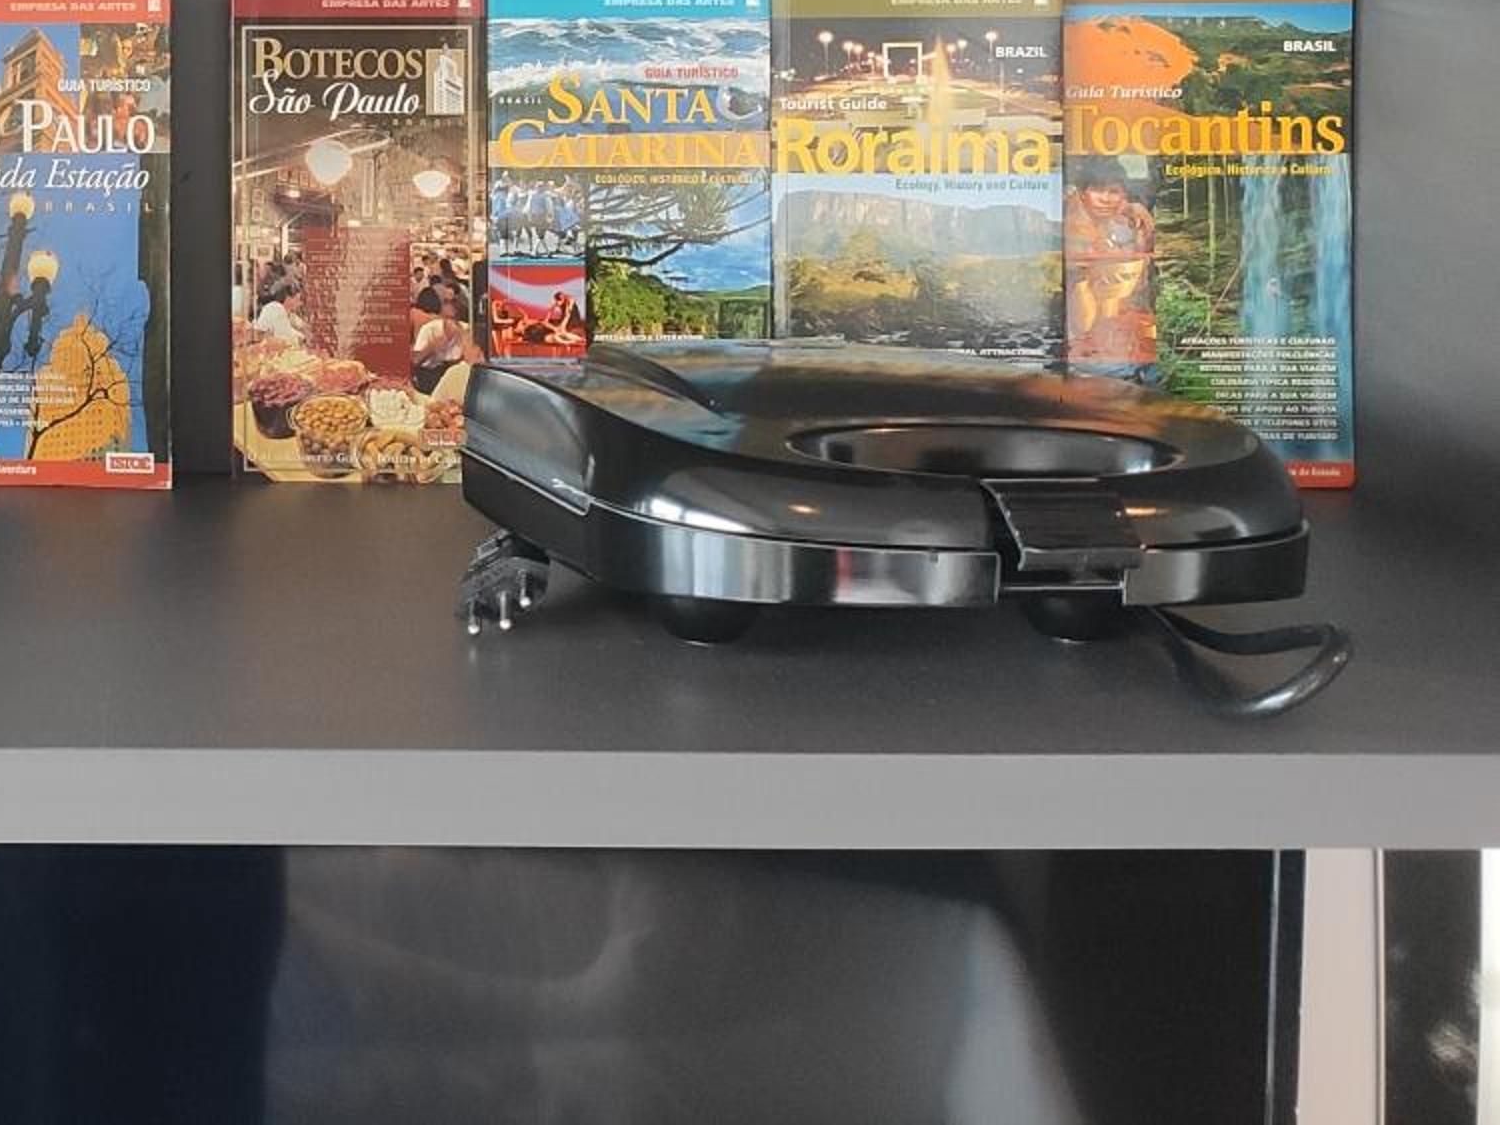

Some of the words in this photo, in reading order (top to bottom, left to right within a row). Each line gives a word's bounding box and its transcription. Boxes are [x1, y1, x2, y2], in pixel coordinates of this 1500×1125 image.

[10, 2, 68, 12] EMPRESA
[71, 2, 95, 12] DAS
[98, 1, 137, 11] ARTES
[321, 0, 380, 8] EMPRESA
[383, 0, 408, 8] DAS
[411, 0, 451, 8] ARTES
[995, 46, 1048, 58] BRAZIL
[1283, 40, 1337, 53] BRASIL
[252, 37, 423, 80] BOTECOS
[644, 67, 673, 79] GUIA
[677, 65, 740, 79] TURÍSTICO
[57, 78, 85, 92] GUIA
[90, 77, 151, 92] TURÍSTICO
[248, 68, 315, 115] São
[322, 81, 424, 122] Paulo
[547, 73, 718, 125] SANTA
[1065, 86, 1105, 99] Guia
[1110, 85, 1183, 99] Turístico
[779, 97, 834, 110] Tourist
[840, 96, 887, 110] Guide
[1064, 101, 1346, 156] Tocantins
[498, 118, 761, 168] CATARINA
[776, 116, 1052, 176] Roraima
[44, 158, 149, 195] Estação
[895, 178, 942, 192] Ecology,
[944, 178, 983, 192] History
[1010, 178, 1049, 191] Culture
